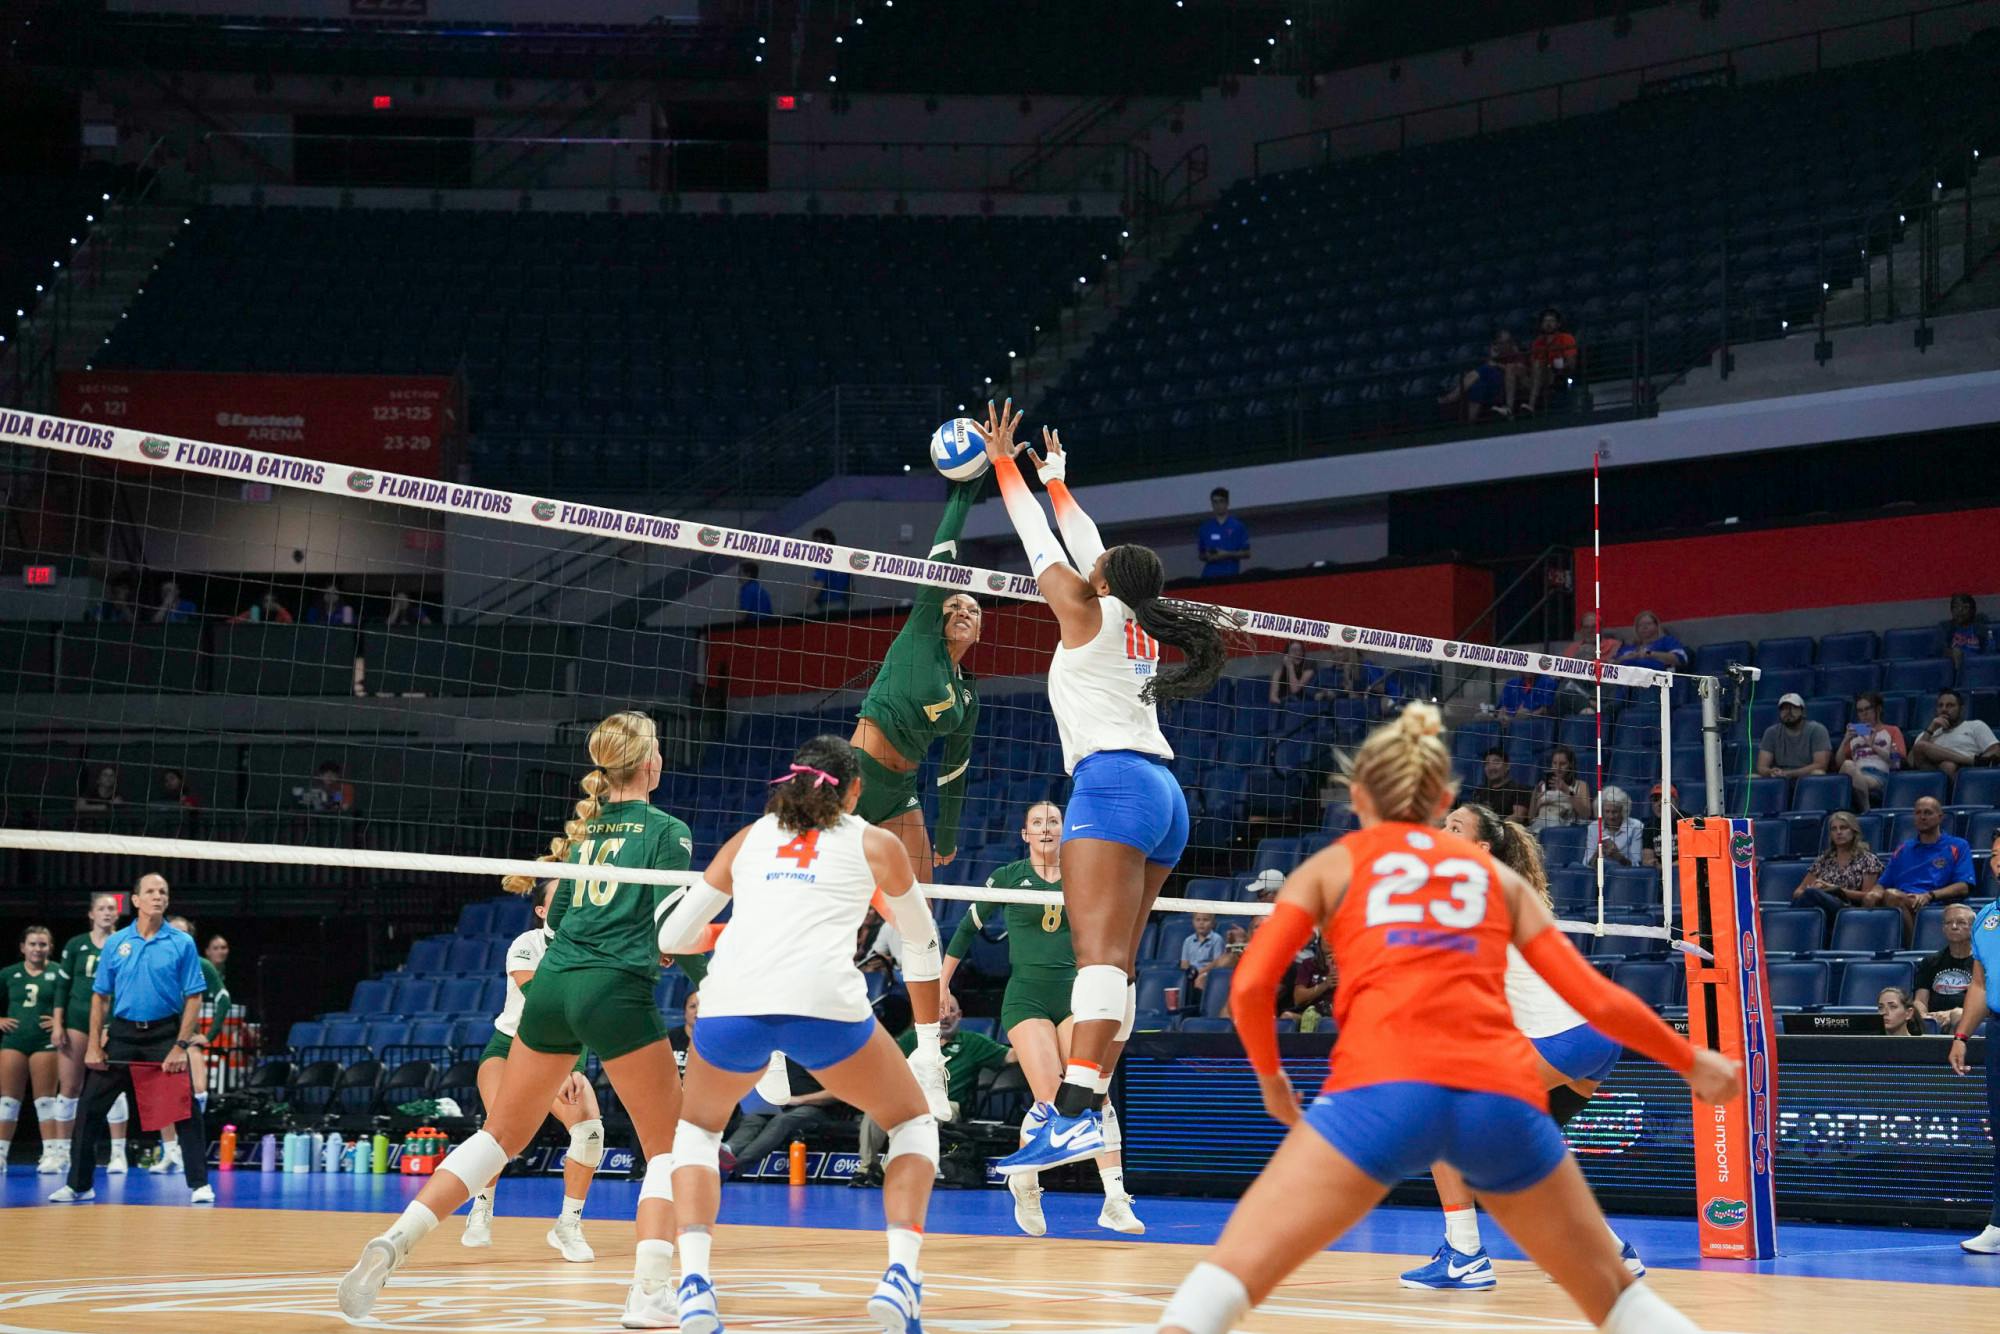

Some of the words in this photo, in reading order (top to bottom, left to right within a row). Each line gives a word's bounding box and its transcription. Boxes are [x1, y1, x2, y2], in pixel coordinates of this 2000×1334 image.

[103, 400, 127, 416] 121
[37, 419, 115, 450] GATORS
[246, 427, 304, 442] ARENA
[175, 442, 253, 473] FLORIDA
[256, 456, 325, 485] GATORS
[378, 475, 448, 504] FLORIDA
[450, 488, 513, 514] GATORS
[560, 505, 622, 531] FLORIDA
[624, 516, 680, 540] GATORS
[723, 531, 780, 557] FLORIDA
[782, 541, 834, 564] GATORS
[872, 555, 925, 579] FLORIDA
[926, 565, 973, 585] GATORS
[1250, 612, 1292, 633] FLORIDA
[1293, 619, 1330, 638] GATORS
[1358, 629, 1397, 648] FLORIDA
[1398, 635, 1434, 653] GATORS
[1459, 644, 1496, 663] FLORIDA
[1496, 650, 1529, 667] GATORS
[1553, 658, 1588, 675] FLORIDA
[586, 822, 645, 834] ORNETS
[776, 828, 820, 869] 4
[572, 837, 627, 907] 16
[1366, 852, 1489, 930] 23
[1042, 903, 1063, 933] 8
[22, 983, 40, 1008] 3
[1674, 1023, 1689, 1031] DV
[1742, 931, 1769, 1176] GATORS
[1713, 1104, 1727, 1123] rts
[1809, 1113, 1969, 1146] OFFICIAL
[410, 1158, 420, 1171] G
[1713, 1124, 1729, 1184] imports
